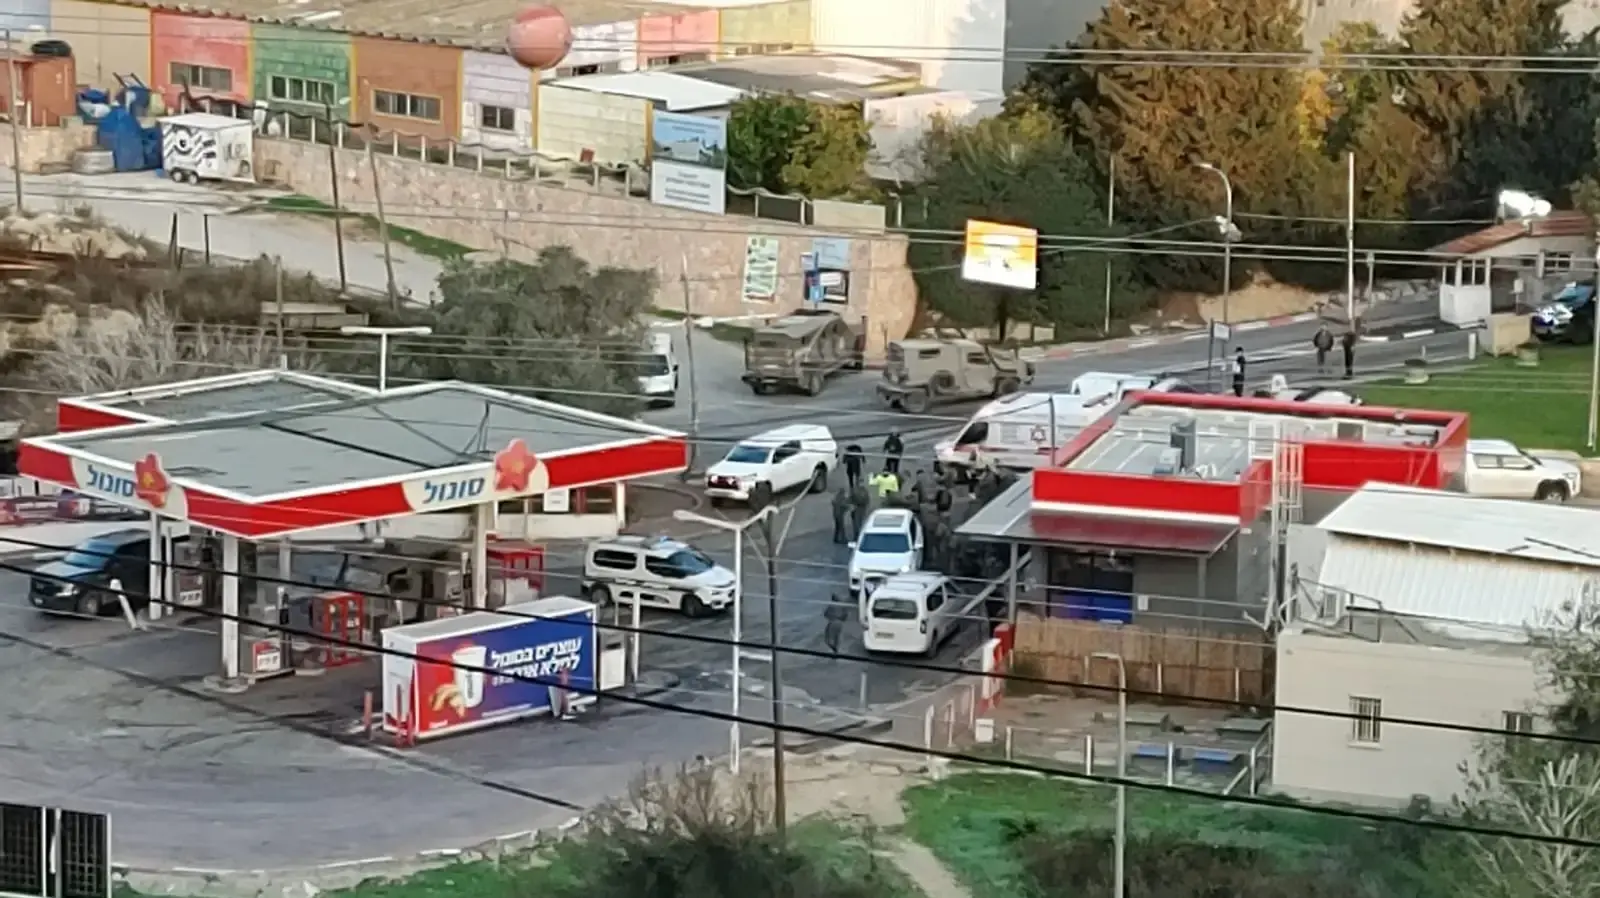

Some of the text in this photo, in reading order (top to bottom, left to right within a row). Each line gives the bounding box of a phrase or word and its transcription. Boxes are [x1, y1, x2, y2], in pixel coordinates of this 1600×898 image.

[86, 463, 136, 497] סונול
[422, 477, 485, 504] סונול
[491, 636, 583, 669] עוצרים בסונול
